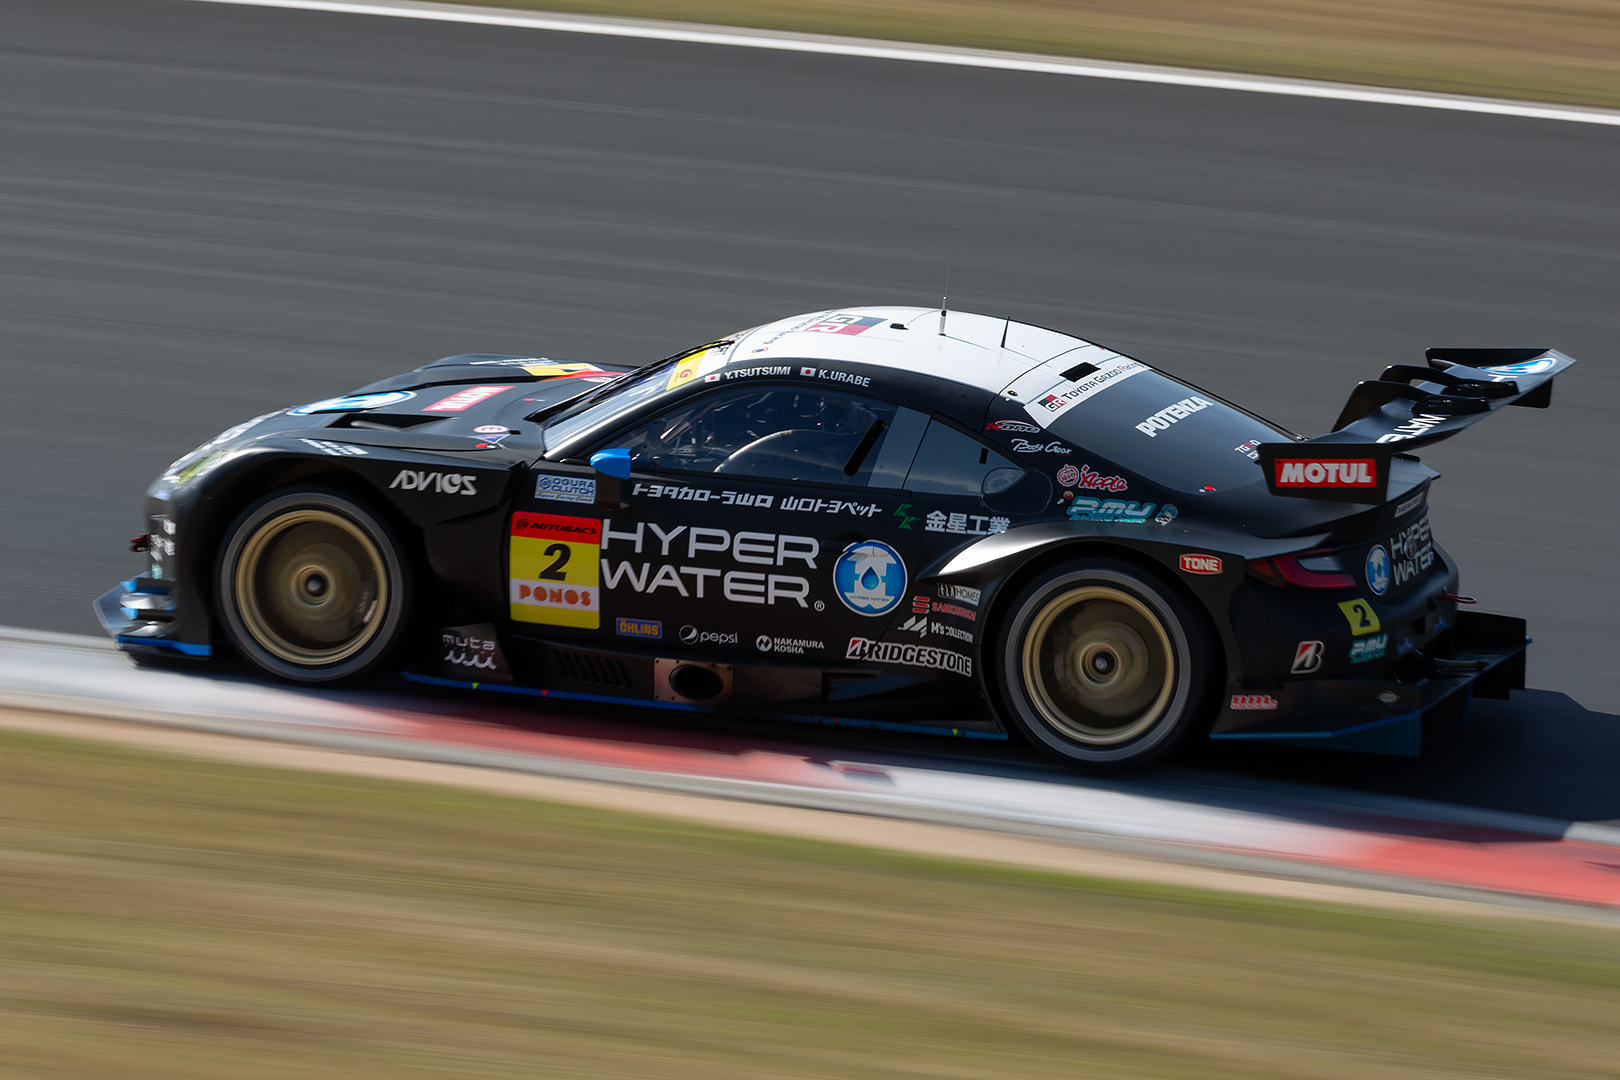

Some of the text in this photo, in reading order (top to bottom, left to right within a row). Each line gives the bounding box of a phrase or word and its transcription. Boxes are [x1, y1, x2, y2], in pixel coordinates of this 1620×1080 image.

[724, 366, 791, 380] Y.TSUTSUMI
[818, 369, 871, 388] K.URABE
[1061, 381, 1098, 400] TOYOTA
[1135, 396, 1214, 438] POTENZA
[1376, 413, 1447, 443] WATE
[388, 469, 478, 496] ADVICS
[1280, 463, 1372, 484] MOTUL
[551, 485, 594, 495] CLUTCH
[779, 495, 883, 518] 山口トヨペット
[530, 522, 597, 535] AUTOBACS
[925, 510, 1011, 535] 金星工業
[601, 518, 820, 569] HYPER
[538, 543, 571, 581] 2
[1183, 557, 1219, 571] TONE
[600, 558, 810, 608] WATER
[519, 585, 591, 606] PONOS
[956, 587, 980, 603] HOMES
[1353, 604, 1371, 628] 2
[699, 632, 739, 645] pepsi
[774, 637, 825, 650] NAKAMURA
[774, 645, 805, 655] KOSHA
[846, 636, 973, 678] BRIDGESTONE
